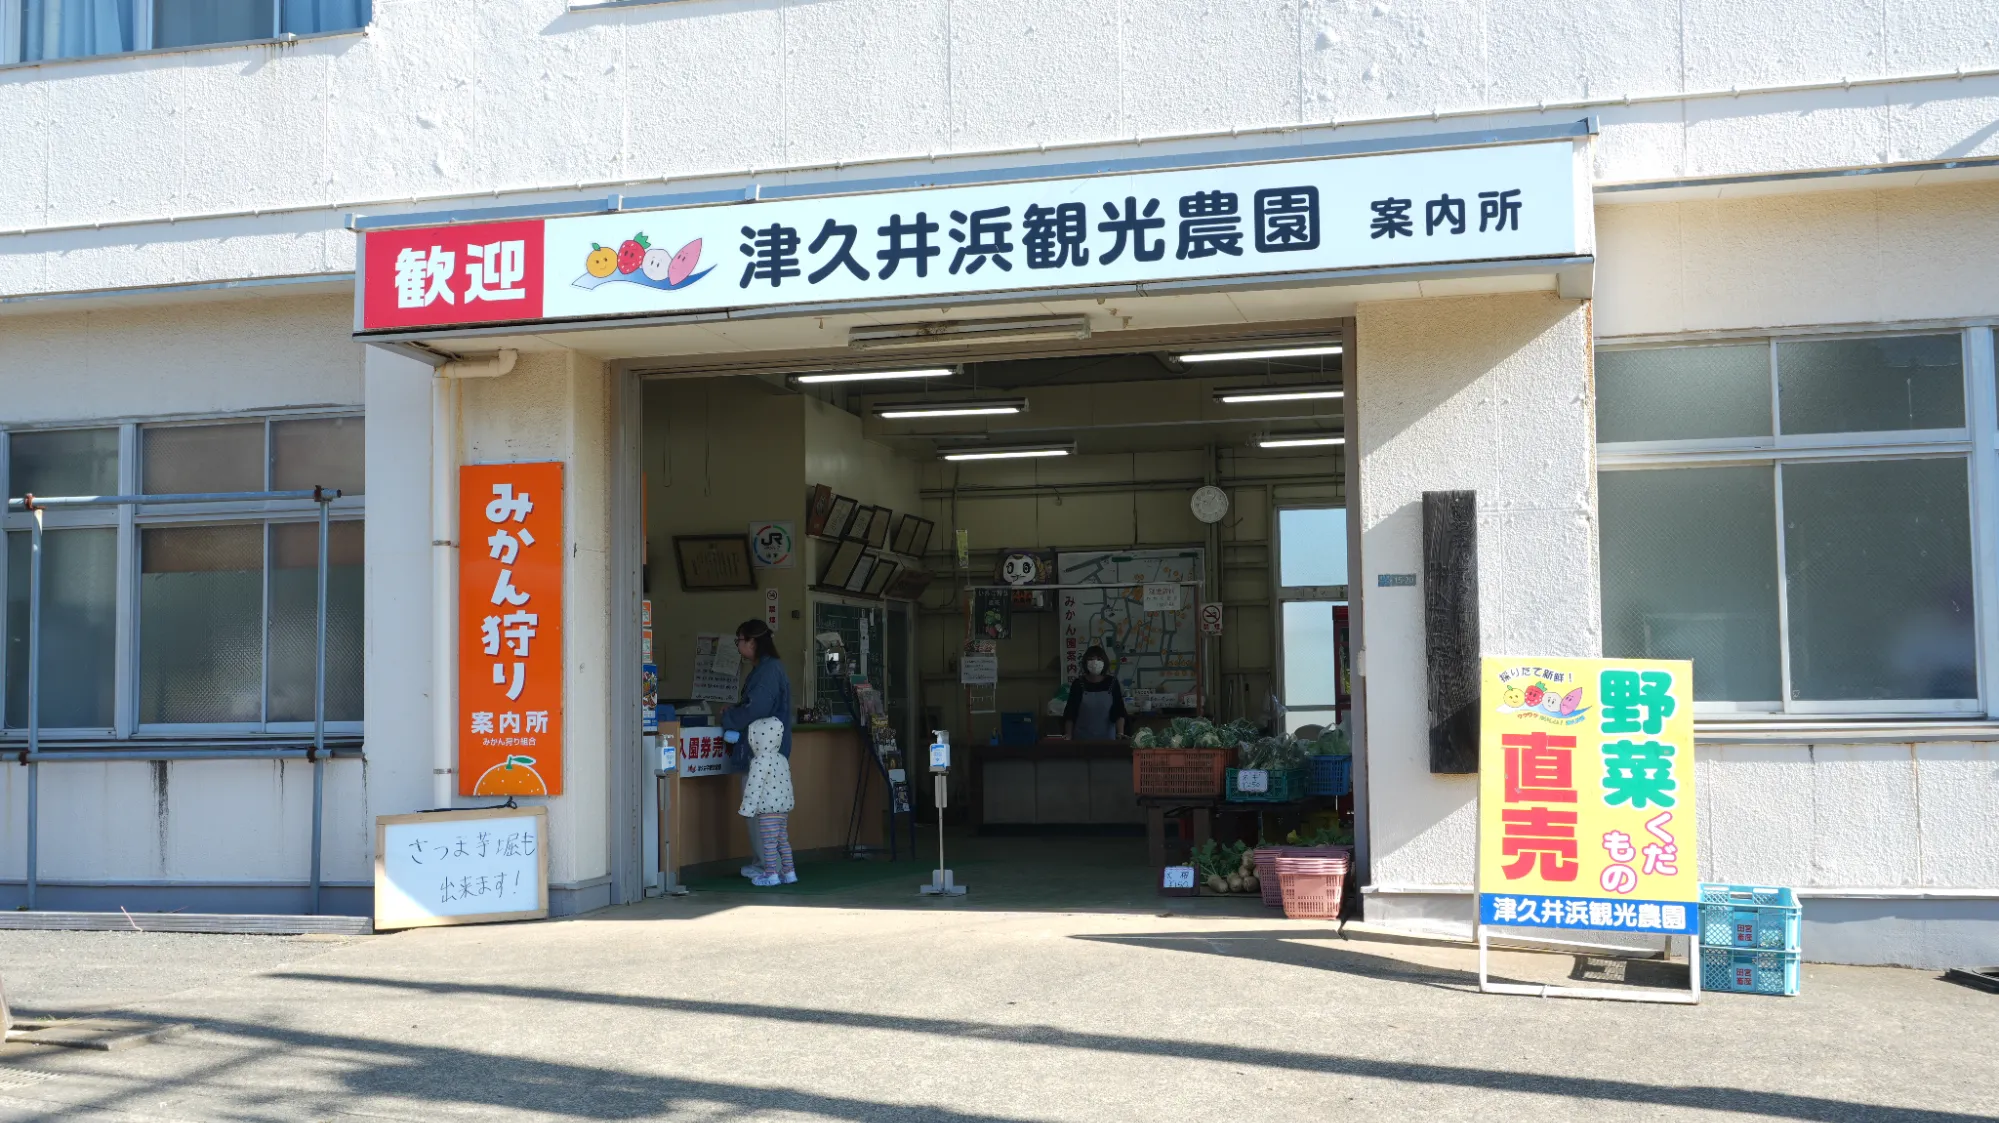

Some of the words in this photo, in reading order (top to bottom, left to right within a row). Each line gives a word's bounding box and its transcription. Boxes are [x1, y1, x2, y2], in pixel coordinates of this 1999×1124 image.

[740, 185, 1320, 289] 津久井浜観光農園
[1370, 188, 1523, 240] 案内所
[395, 240, 526, 309] 歓迎
[761, 533, 783, 546] JR
[481, 483, 539, 701] みかん狩り
[471, 711, 549, 734] 案内所
[482, 736, 537, 747] みかん狩り組合
[1600, 670, 1676, 808] 野菜
[1501, 731, 1579, 883] 直売
[1493, 896, 1687, 931] 津久井浜観光農園
